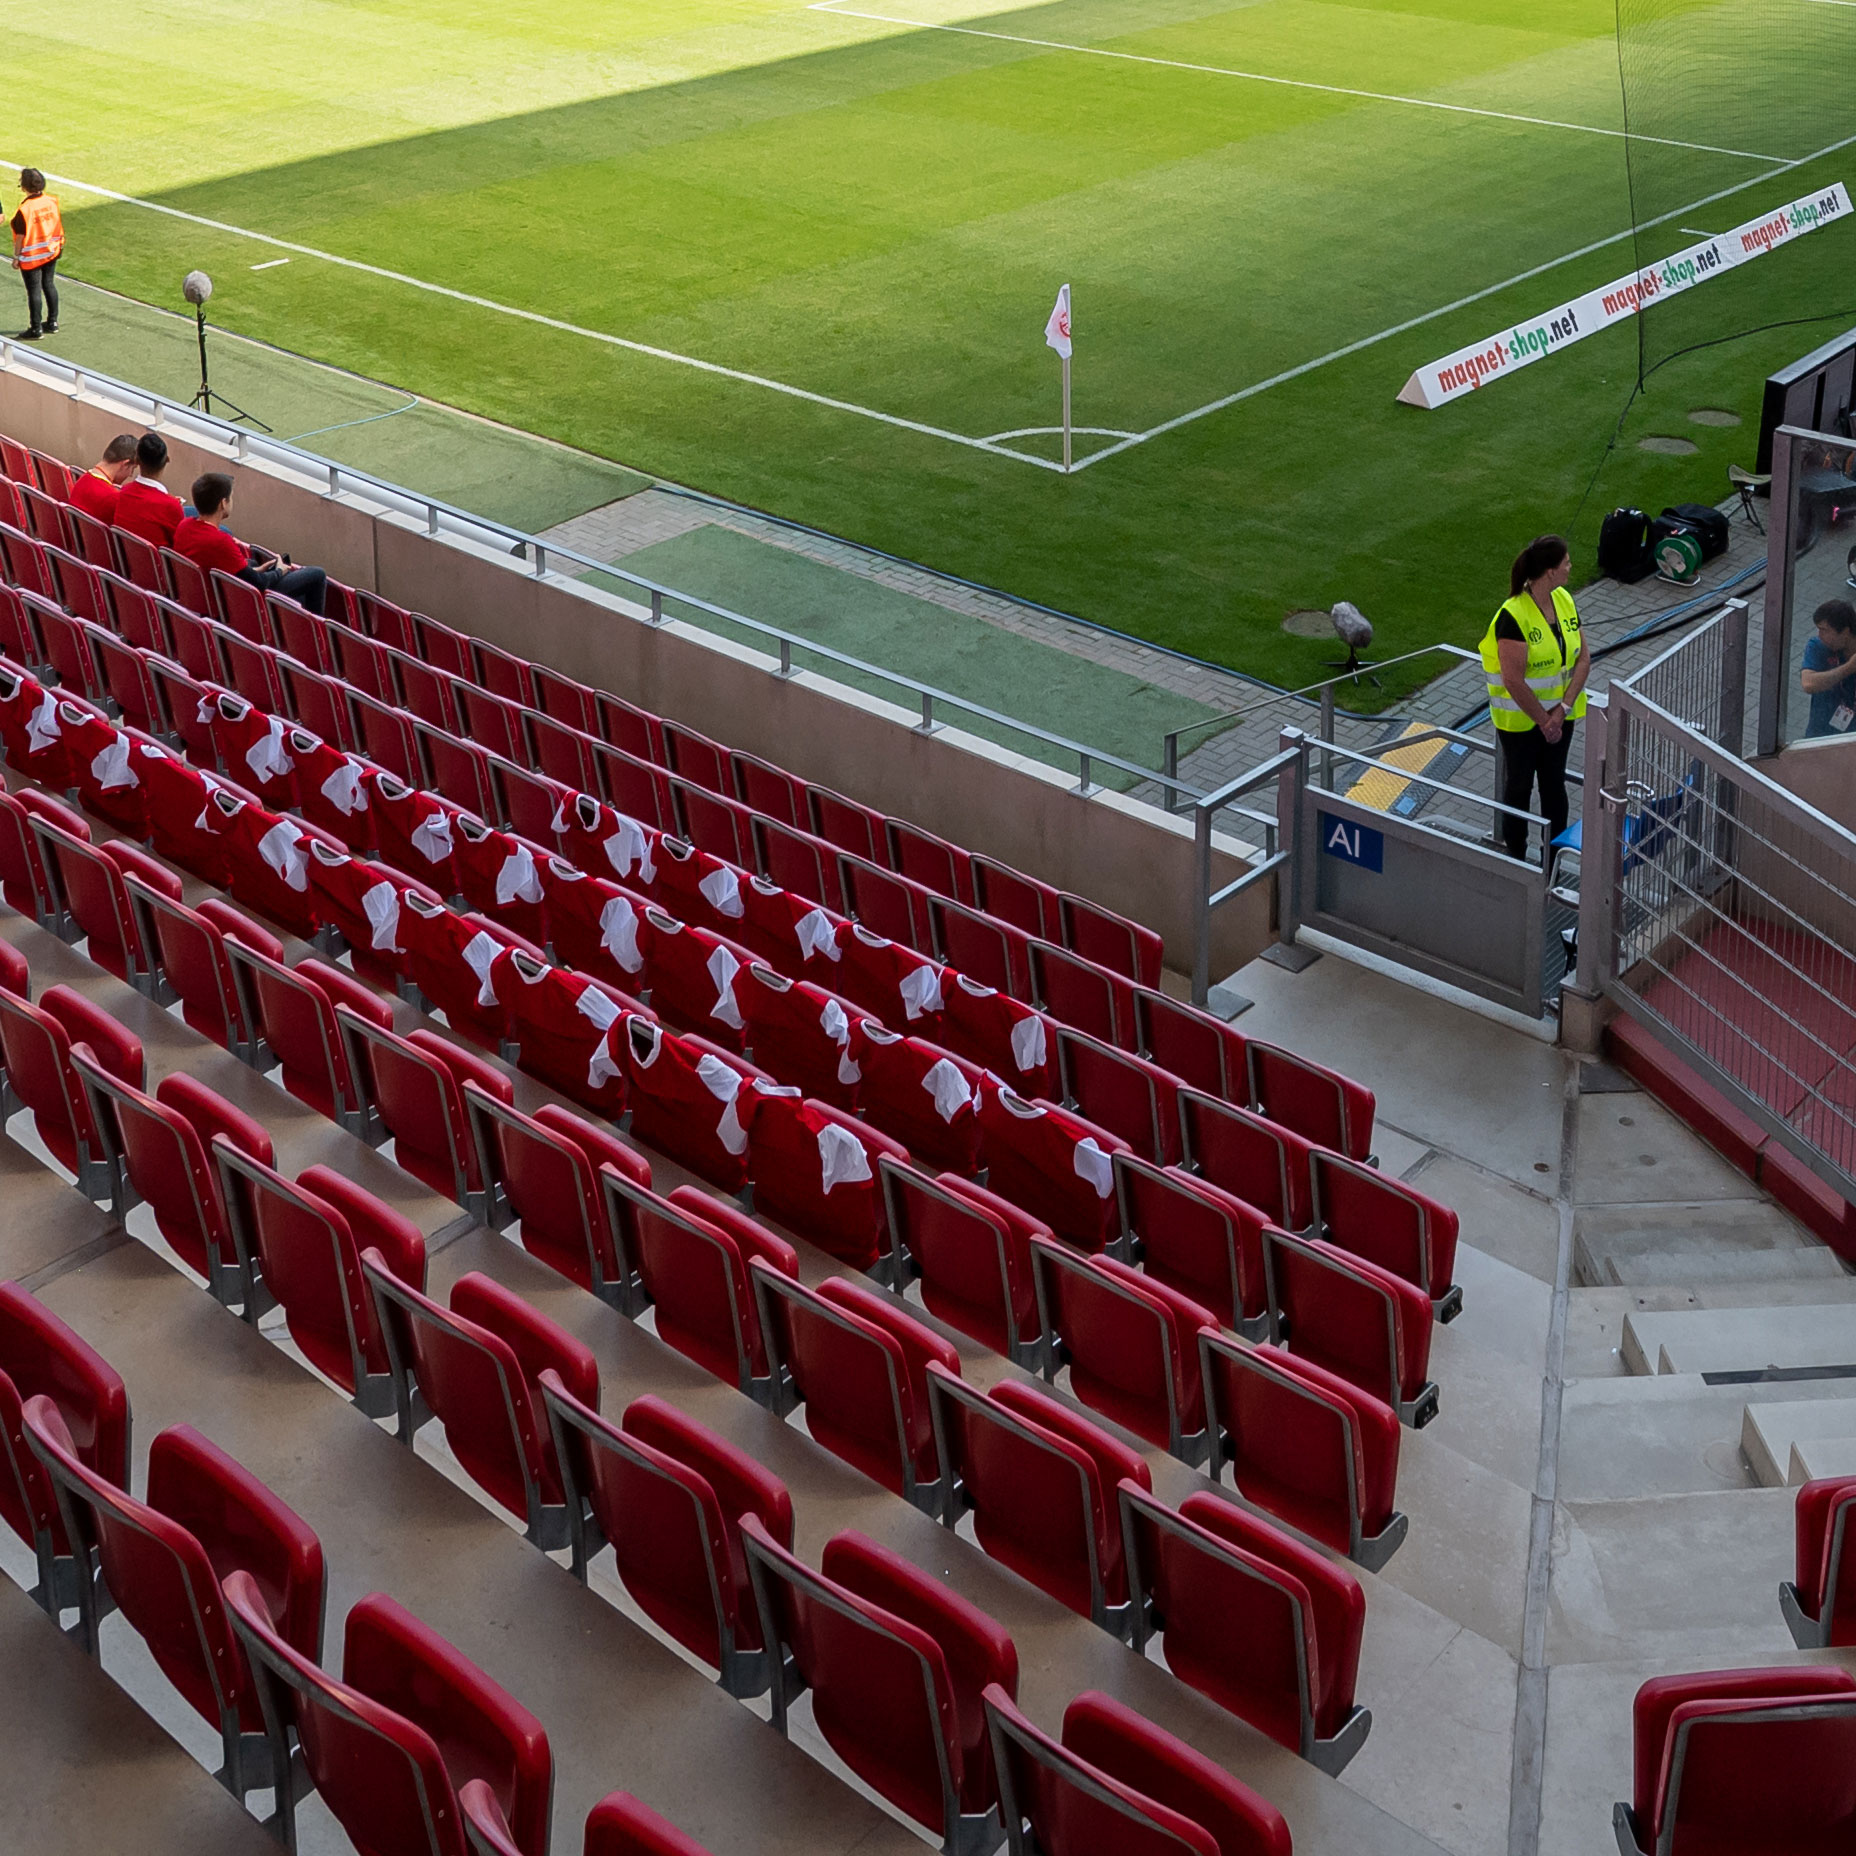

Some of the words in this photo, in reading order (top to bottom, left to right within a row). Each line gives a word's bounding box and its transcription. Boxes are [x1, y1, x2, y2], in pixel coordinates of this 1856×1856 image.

[1741, 189, 1840, 253] magnet-shop.net
[1602, 243, 1722, 316] magnet-shop.net
[1438, 308, 1580, 394] magnet-shop.net
[1563, 617, 1579, 633] 35
